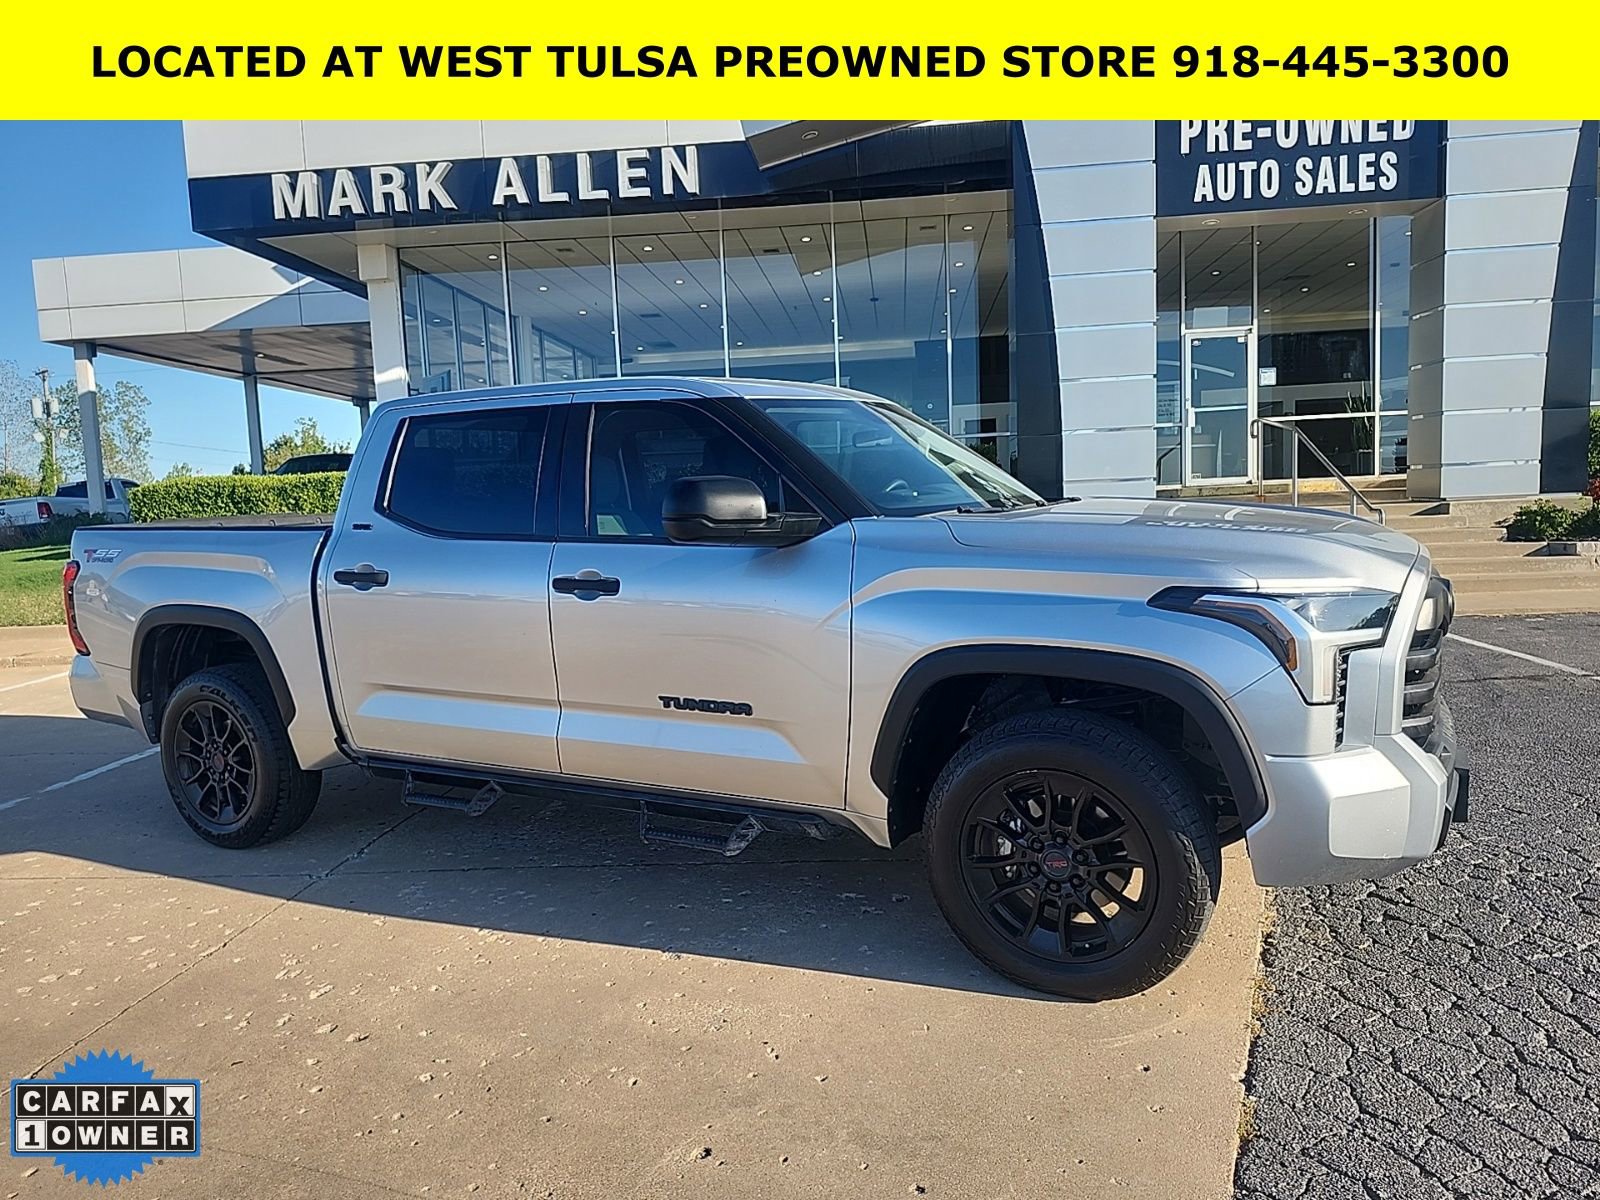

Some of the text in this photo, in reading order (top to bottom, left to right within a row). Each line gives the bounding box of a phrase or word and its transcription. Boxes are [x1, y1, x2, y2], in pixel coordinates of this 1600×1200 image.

[271, 145, 700, 219] MARK ALLEN
[1193, 151, 1398, 202] AUTO SALES
[658, 696, 753, 716] TUNDRA
